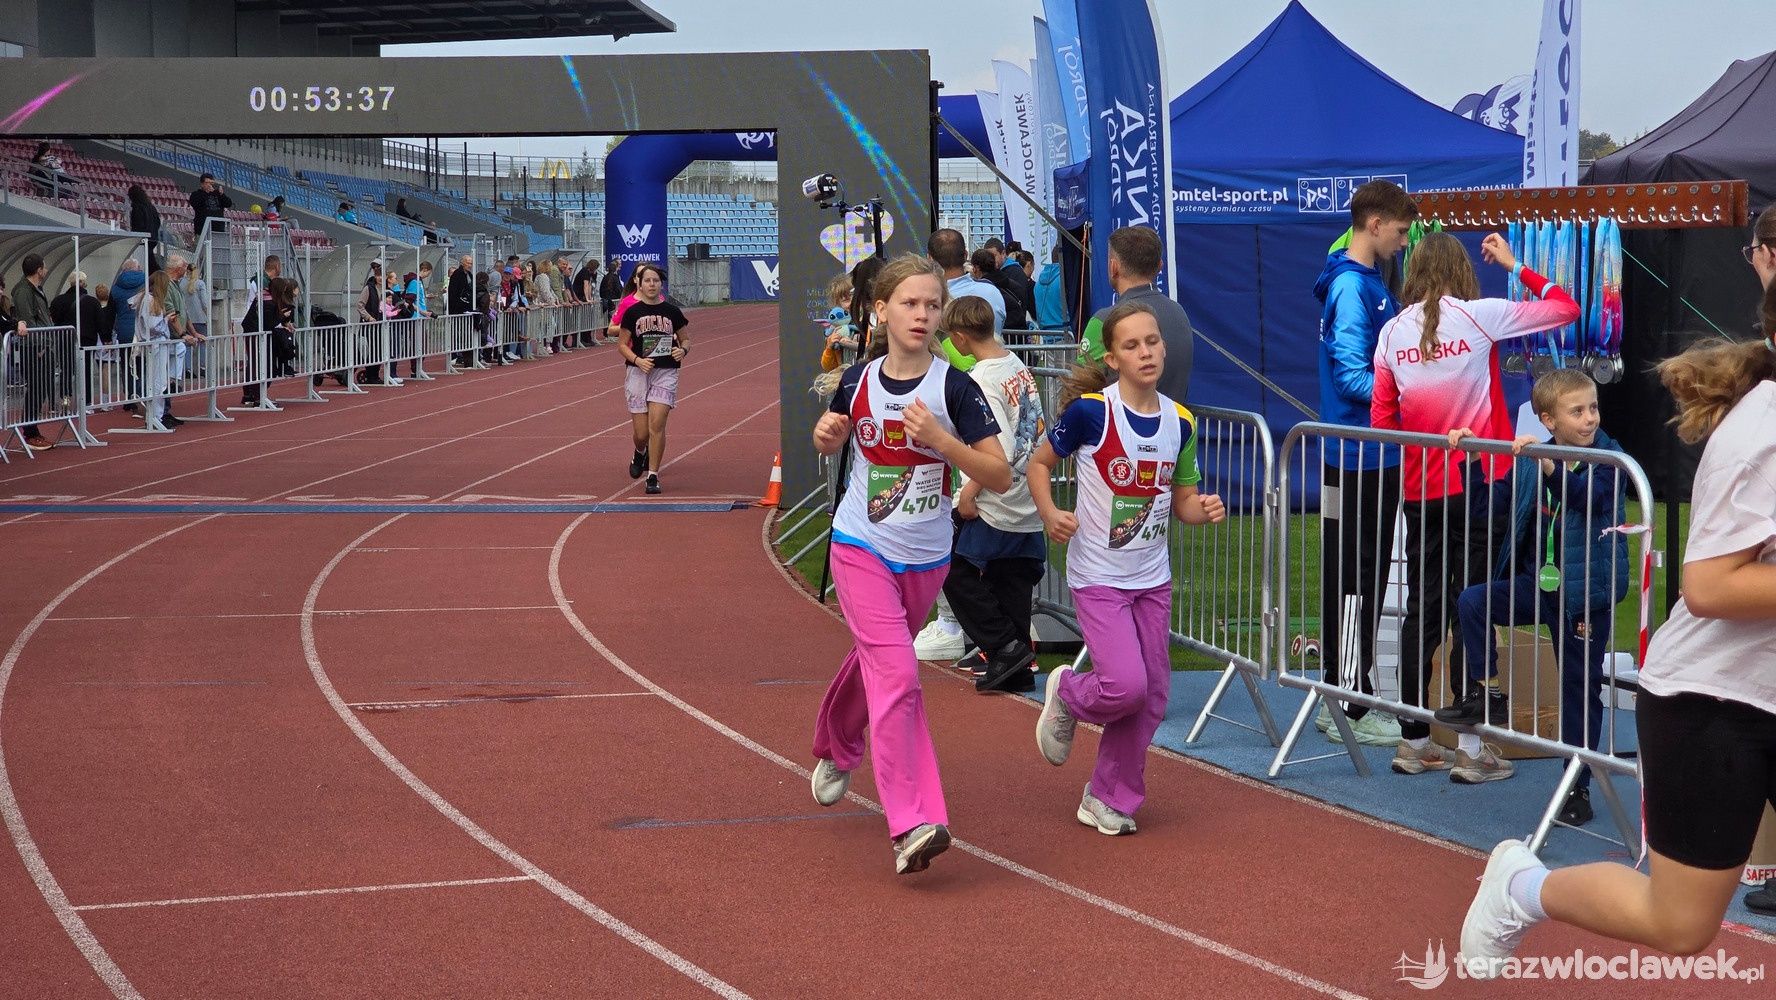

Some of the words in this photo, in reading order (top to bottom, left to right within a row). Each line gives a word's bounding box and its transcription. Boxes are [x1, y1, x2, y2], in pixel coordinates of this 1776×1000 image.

[249, 86, 396, 112] 00:53:37
[1175, 205, 1209, 213] systemy
[1211, 205, 1246, 213] pomiaru
[655, 346, 671, 354] 454
[1396, 338, 1471, 366] POSKA
[902, 493, 940, 515] 470
[1141, 522, 1166, 540] 474
